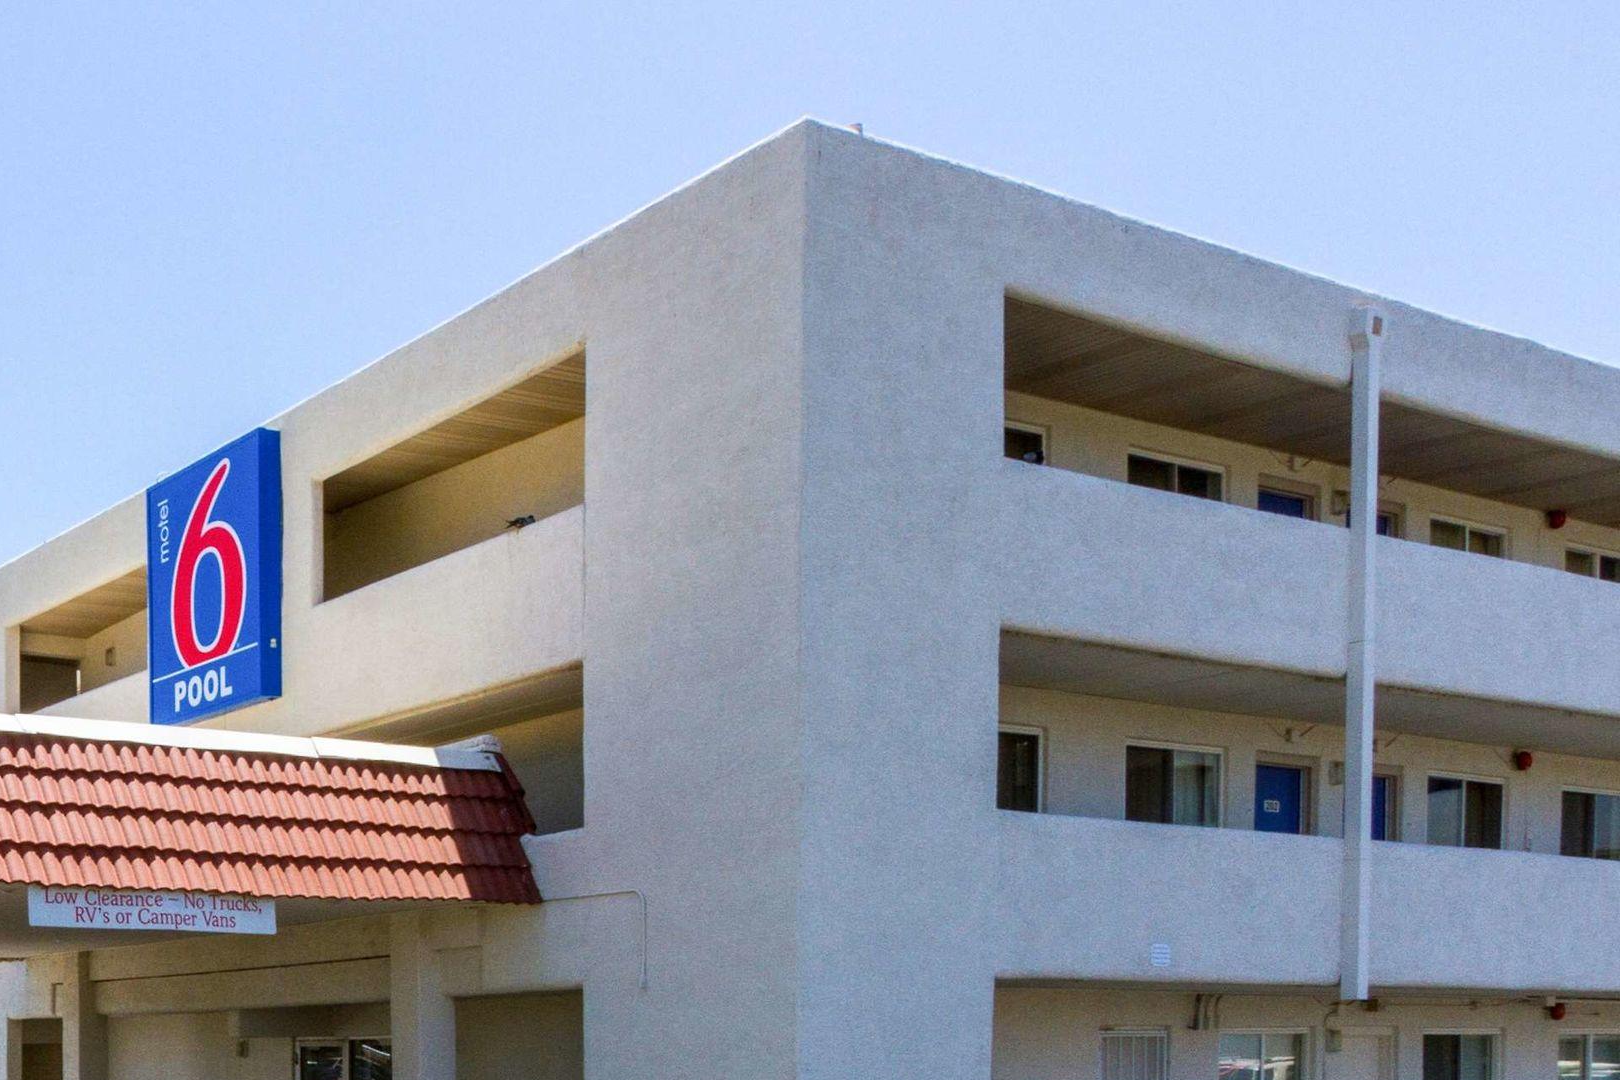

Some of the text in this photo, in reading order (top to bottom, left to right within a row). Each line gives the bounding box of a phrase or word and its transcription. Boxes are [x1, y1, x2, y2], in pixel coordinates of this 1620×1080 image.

[157, 499, 169, 563] motel
[170, 457, 247, 669] 6
[174, 666, 232, 712] POOL
[44, 888, 78, 904] Low
[84, 889, 163, 907] Clearance
[184, 893, 205, 909] No
[209, 894, 262, 914] Trucks,
[75, 906, 236, 929] RV's or Camper Vans
